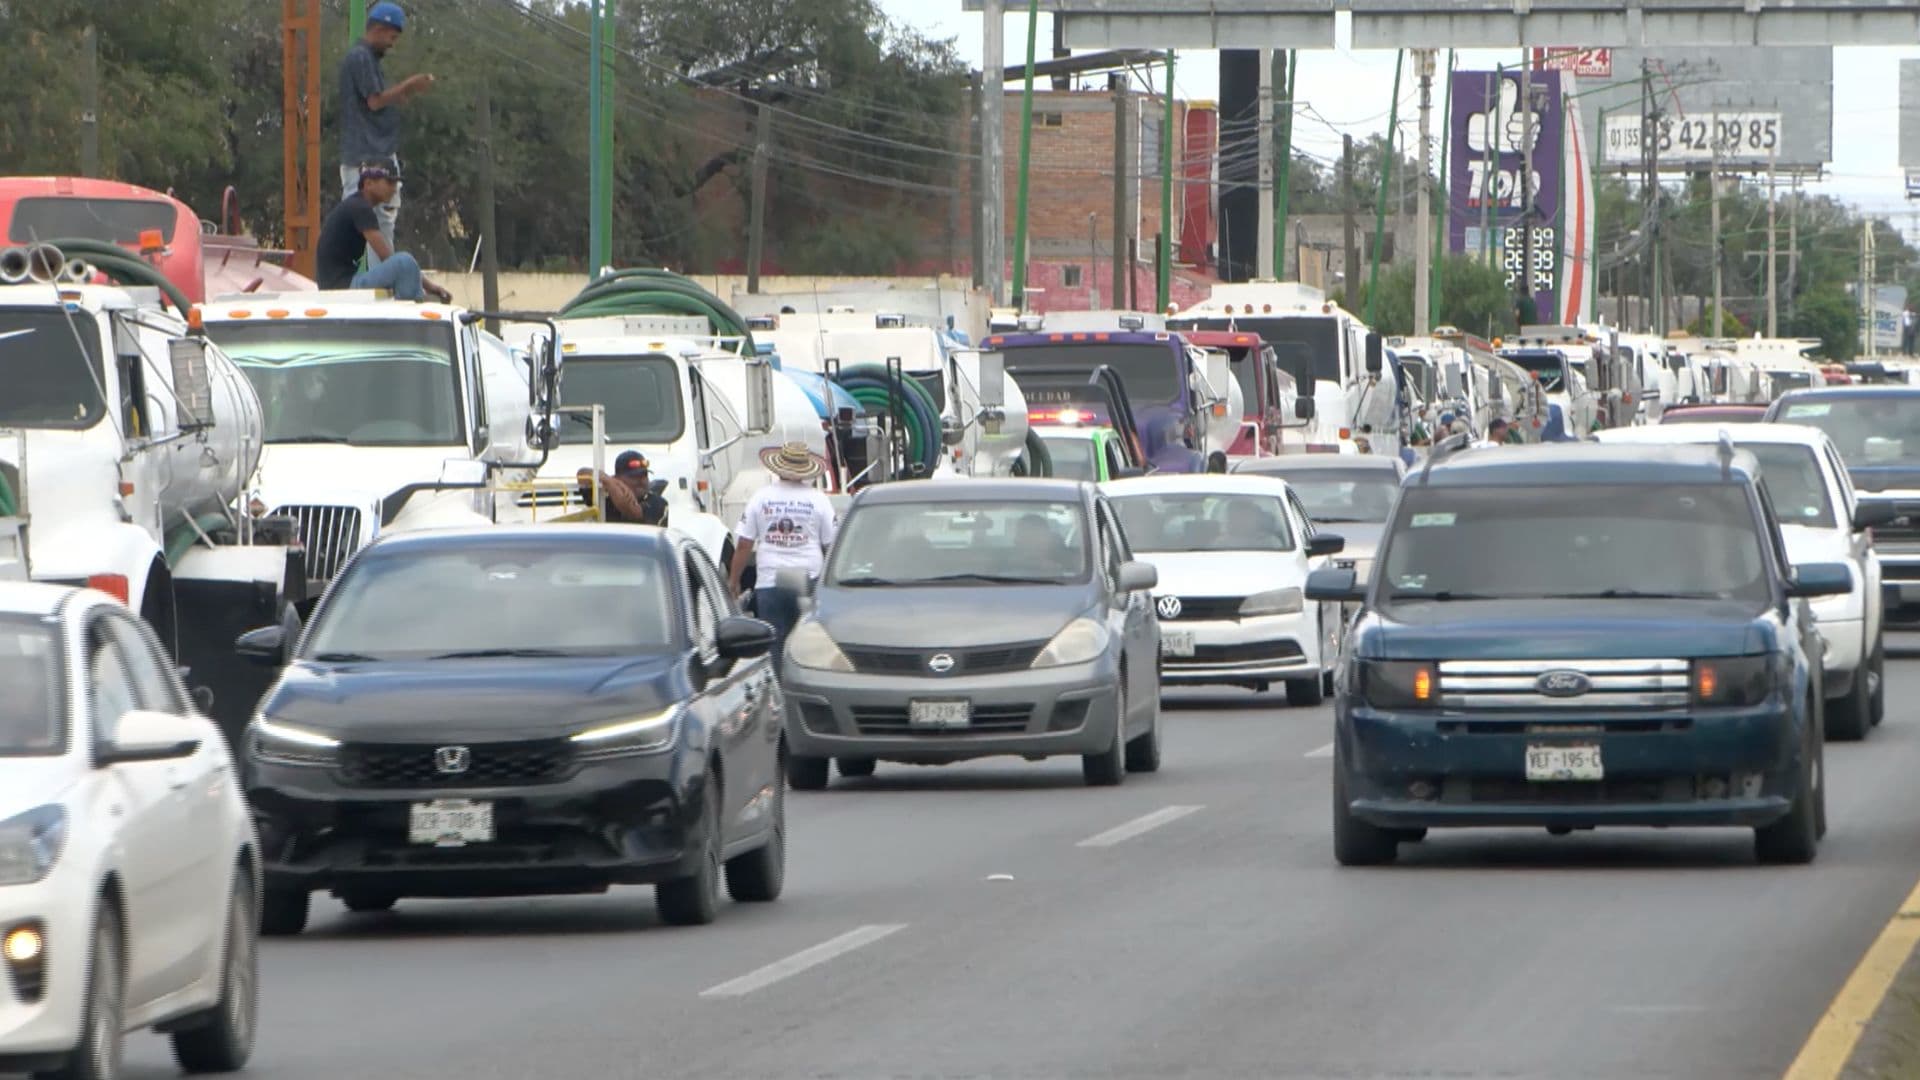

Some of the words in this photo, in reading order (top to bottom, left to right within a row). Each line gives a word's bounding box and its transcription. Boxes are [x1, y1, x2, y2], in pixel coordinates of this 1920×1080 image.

[1579, 49, 1609, 66] 24
[1679, 120, 1707, 150] 42
[1748, 119, 1777, 149] 85
